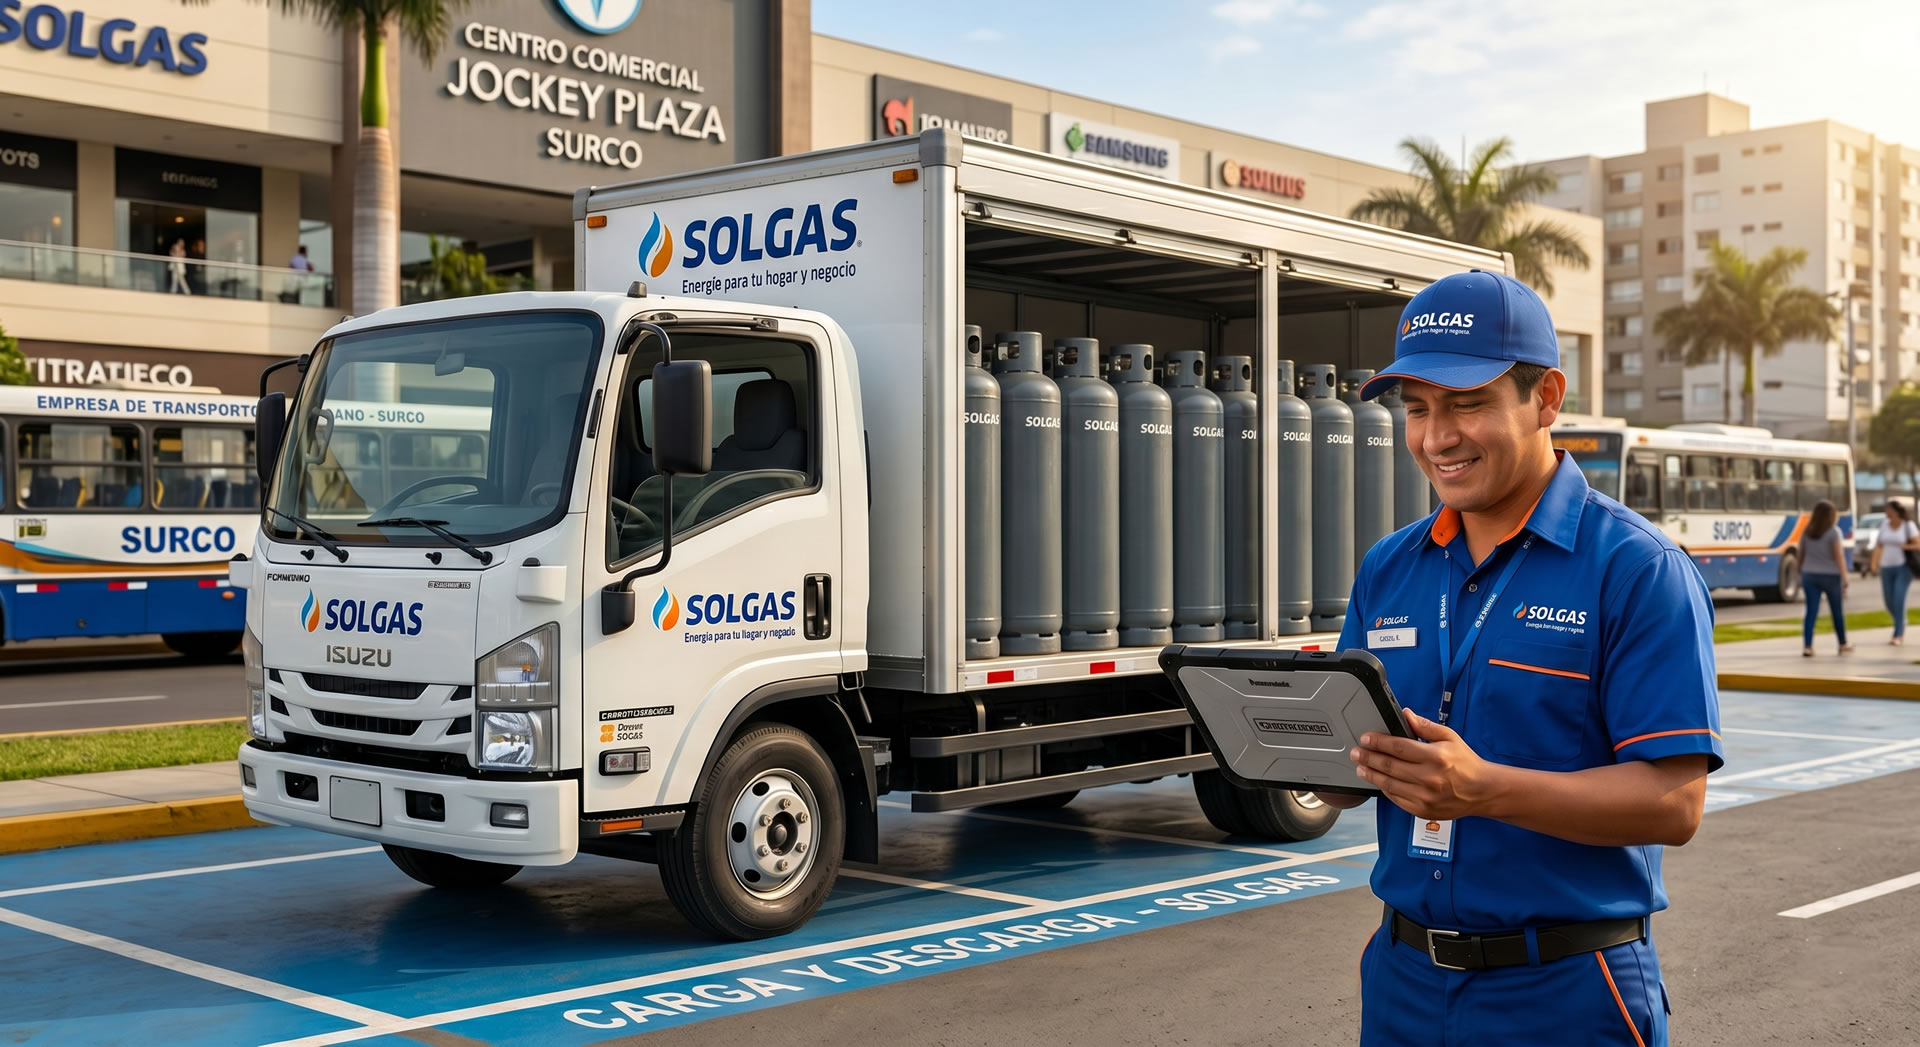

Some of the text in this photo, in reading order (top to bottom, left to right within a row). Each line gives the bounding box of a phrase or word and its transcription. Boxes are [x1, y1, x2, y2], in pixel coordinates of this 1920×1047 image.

[0, 0, 208, 76] SOLGAS
[464, 22, 704, 92] CENTRO COMERCIAL
[447, 57, 727, 143] JOCKEY PLAZA
[0, 147, 40, 169] OTS
[547, 127, 643, 169] SURCO
[682, 198, 858, 269] SOLGAS
[724, 276, 748, 293] para
[751, 272, 762, 287] tu
[766, 270, 798, 288] hogar
[801, 271, 808, 285] y
[811, 260, 857, 283] negocio
[1411, 312, 1474, 330] SOLGAS
[37, 395, 120, 412] EMPRESA
[126, 399, 147, 413] DE
[377, 410, 425, 423] SURCO
[964, 411, 1000, 425] SOLGAS
[121, 526, 236, 553] SURCO
[1713, 521, 1751, 541] SURCO
[325, 598, 424, 636] SOLGAS
[685, 591, 796, 626] SOLGAS
[1382, 615, 1409, 625] SOLGAS
[1527, 605, 1587, 625] SOLGAS
[714, 632, 732, 643] para
[733, 630, 741, 640] tu
[763, 630, 768, 640] y
[326, 645, 392, 667] ISUZU
[563, 976, 804, 1030] CARGA
[781, 964, 847, 984] Y
[833, 912, 1139, 975] DESCARGA
[1154, 871, 1341, 911] SOLGAS
